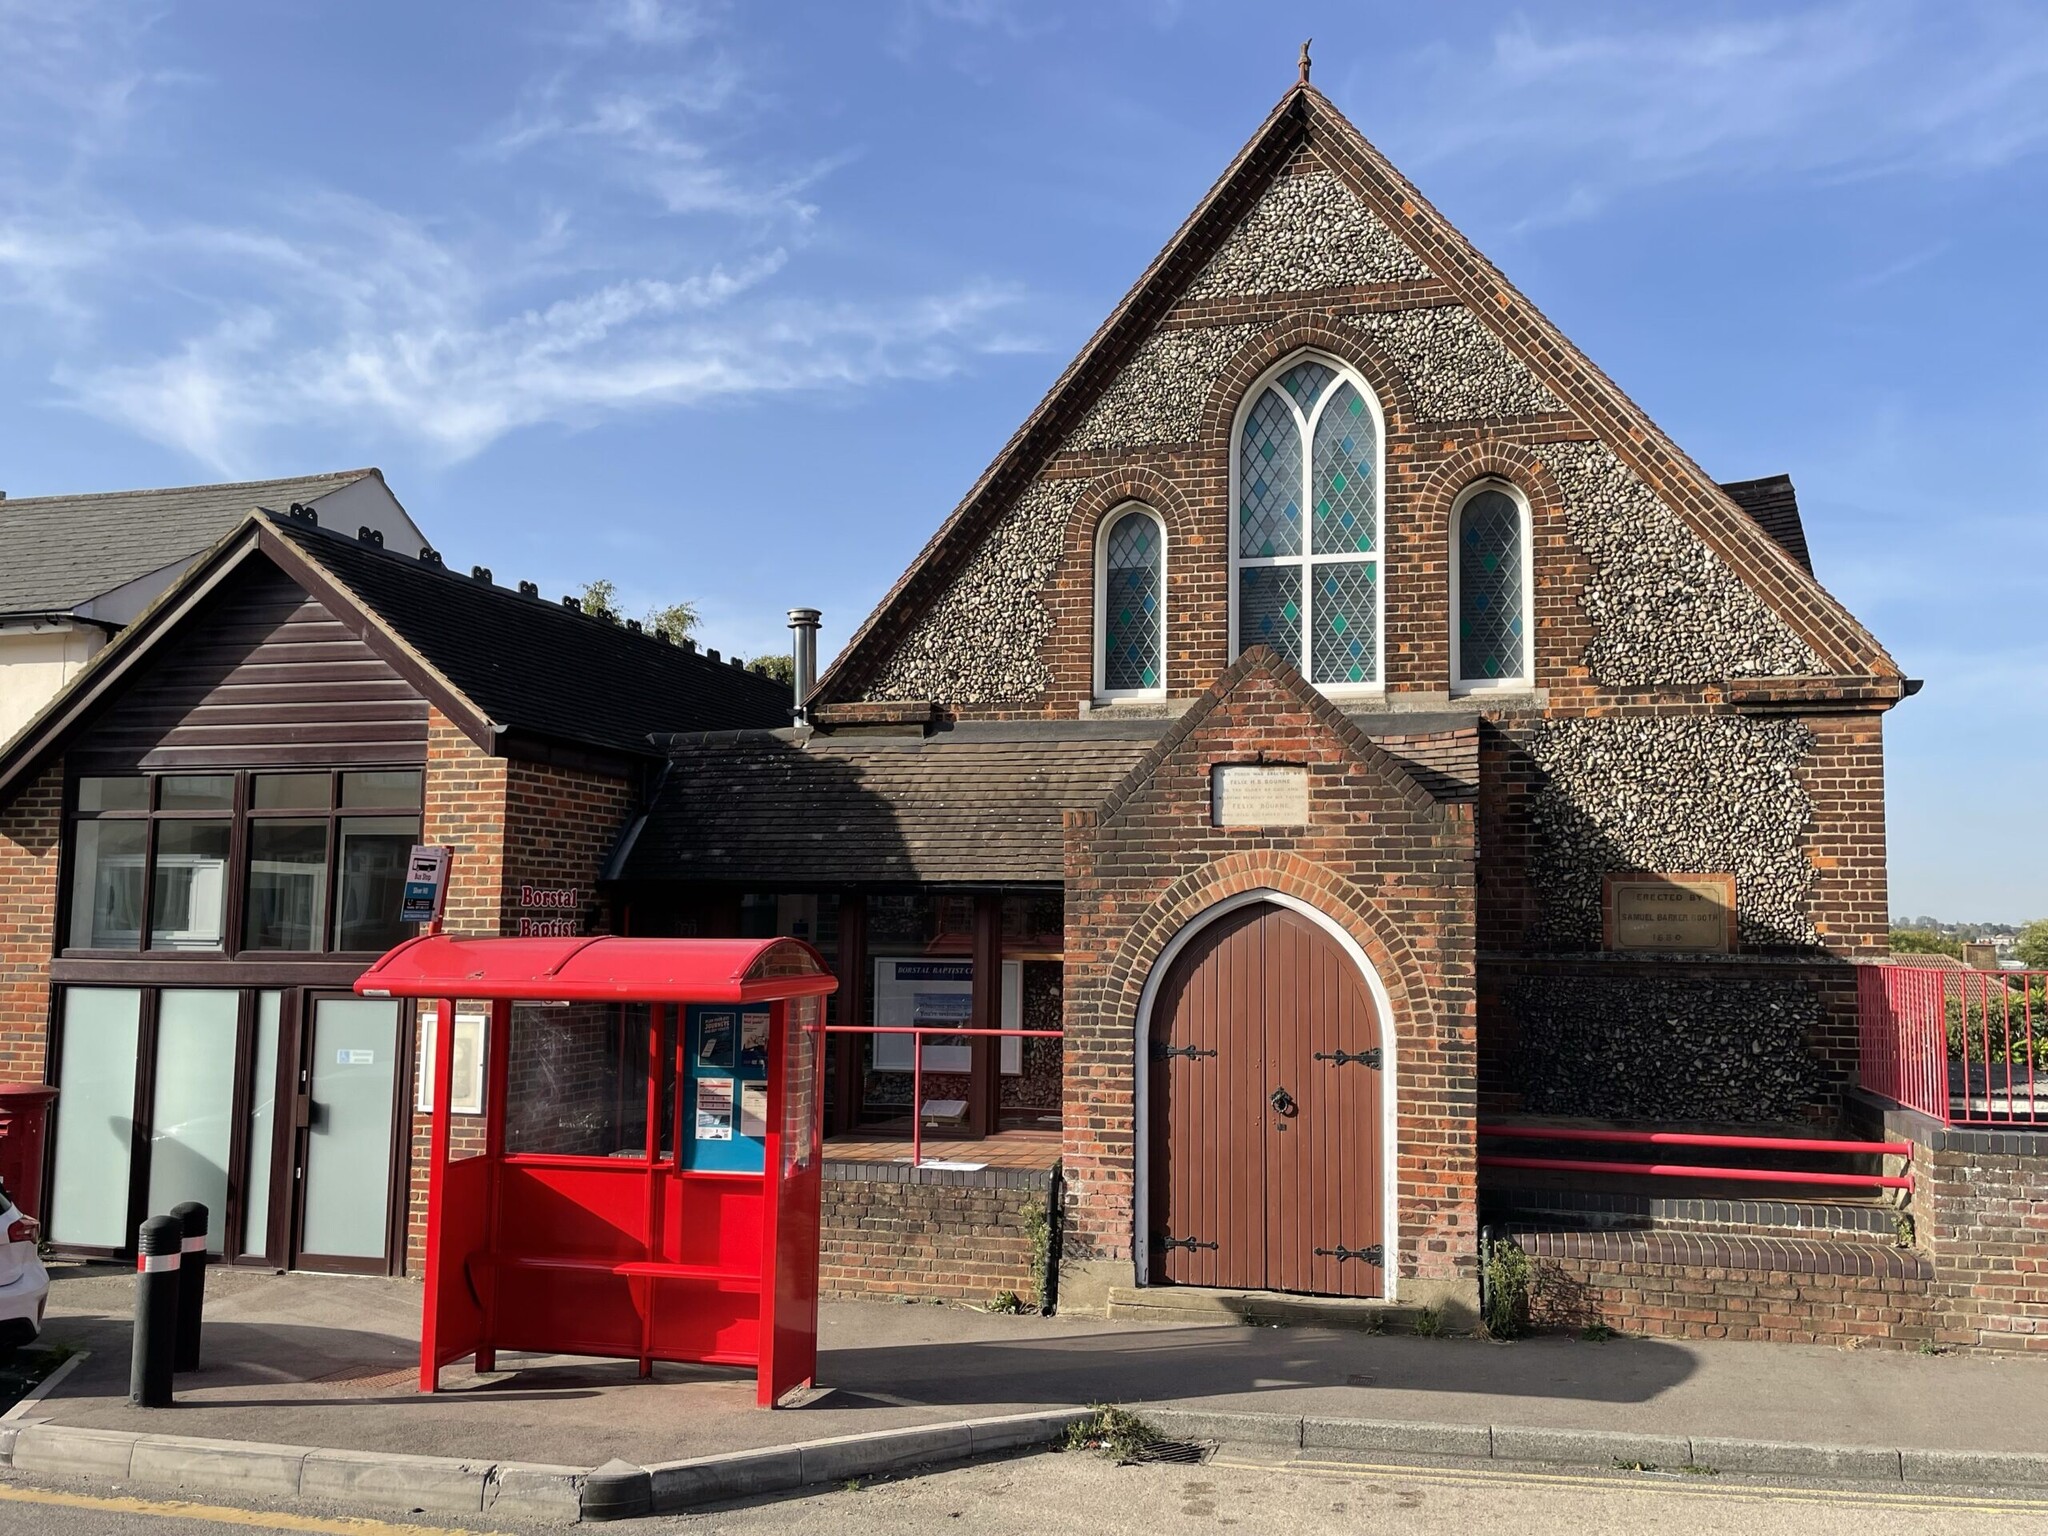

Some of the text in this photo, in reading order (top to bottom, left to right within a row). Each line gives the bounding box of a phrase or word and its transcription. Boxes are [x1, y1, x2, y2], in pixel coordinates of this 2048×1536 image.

[422, 873, 432, 882] Stop
[521, 885, 578, 908] Borstal
[1636, 893, 1703, 901] ERECTED BY
[1621, 913, 1654, 922] SAMUEL
[1657, 913, 1689, 922] BARKER
[519, 917, 577, 937] Baptist
[897, 967, 931, 975] BORSTAL
[932, 967, 965, 975] BAPTIST
[704, 1021, 730, 1030] JOURNEYS
